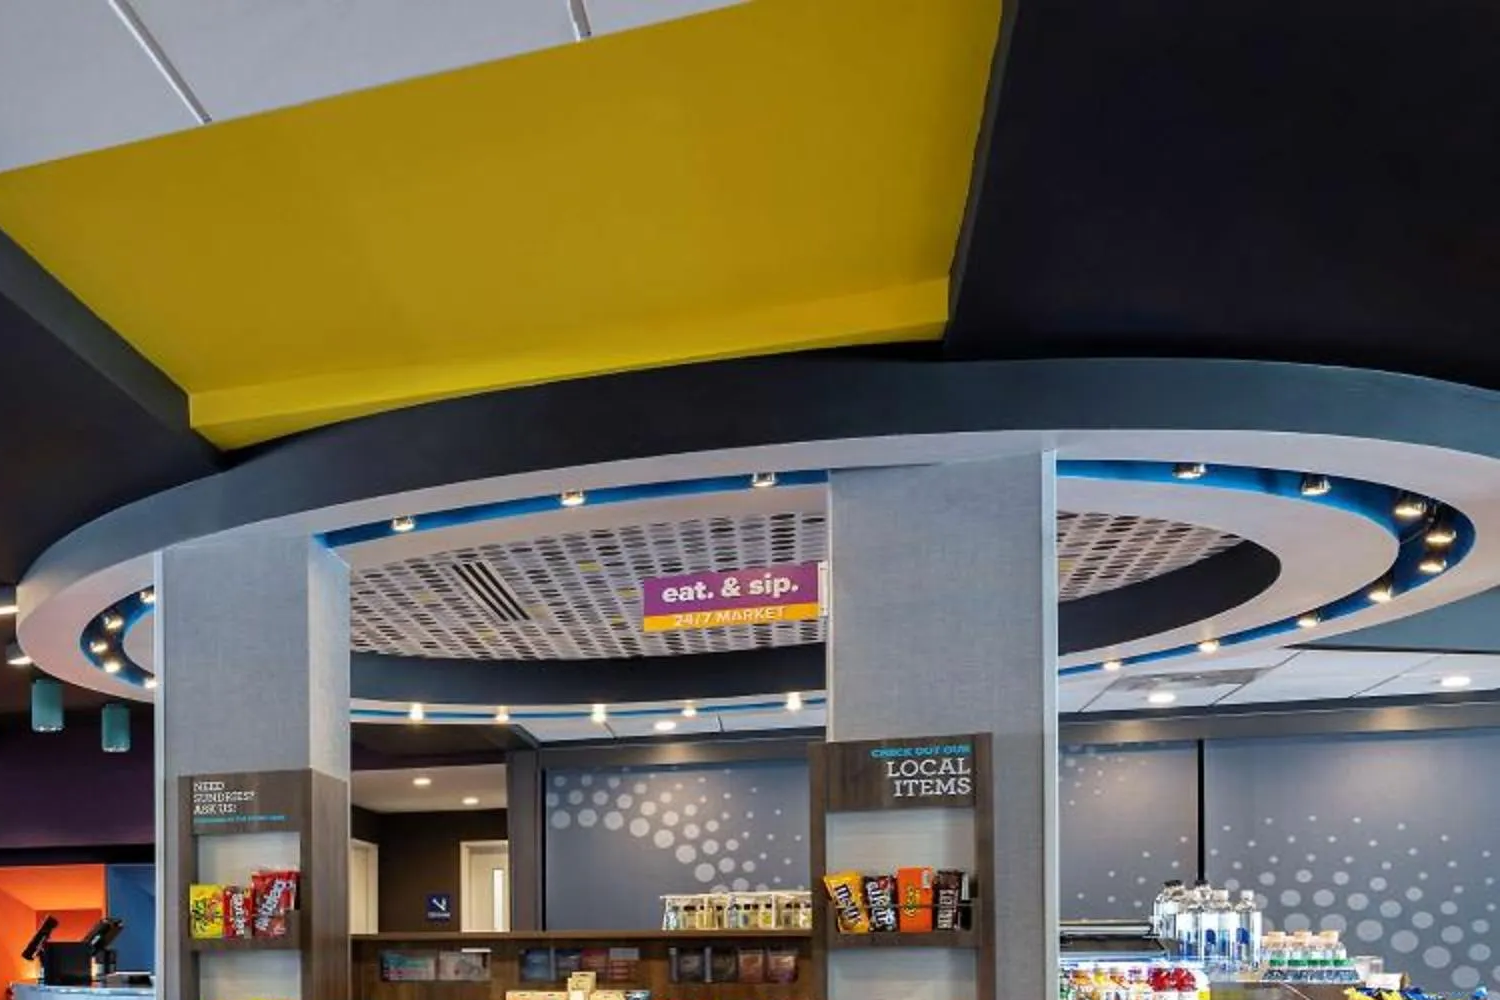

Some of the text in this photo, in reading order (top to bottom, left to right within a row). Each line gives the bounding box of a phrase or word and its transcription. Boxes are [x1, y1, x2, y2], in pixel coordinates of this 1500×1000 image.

[661, 572, 799, 603] eat. & sip.
[675, 607, 786, 627] 24/7 MARKET
[886, 757, 971, 777] LOCAL
[893, 777, 972, 797] ITEMS
